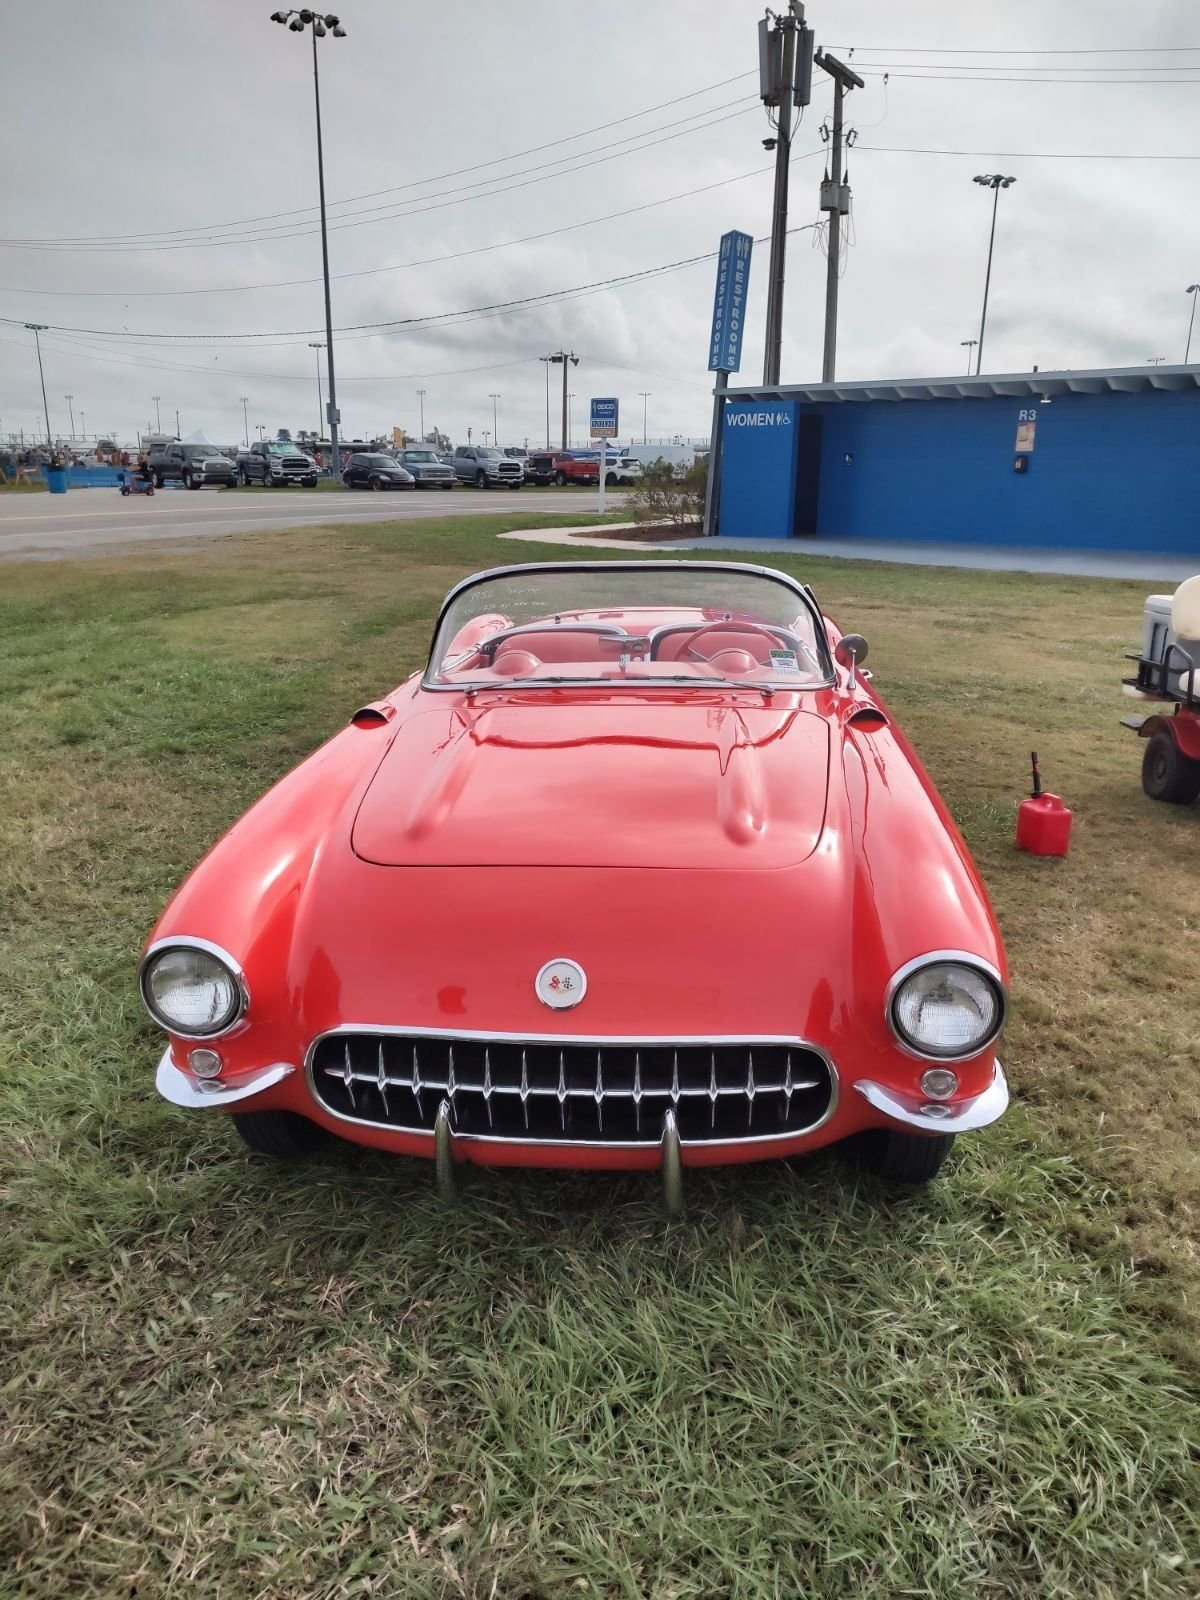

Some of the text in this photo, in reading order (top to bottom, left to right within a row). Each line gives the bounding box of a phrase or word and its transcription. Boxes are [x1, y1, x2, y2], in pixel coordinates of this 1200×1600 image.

[711, 260, 728, 366] RESTROOMS
[727, 259, 745, 367] RESTROOMS
[726, 412, 775, 427] WOMEN
[1018, 409, 1037, 421] R3
